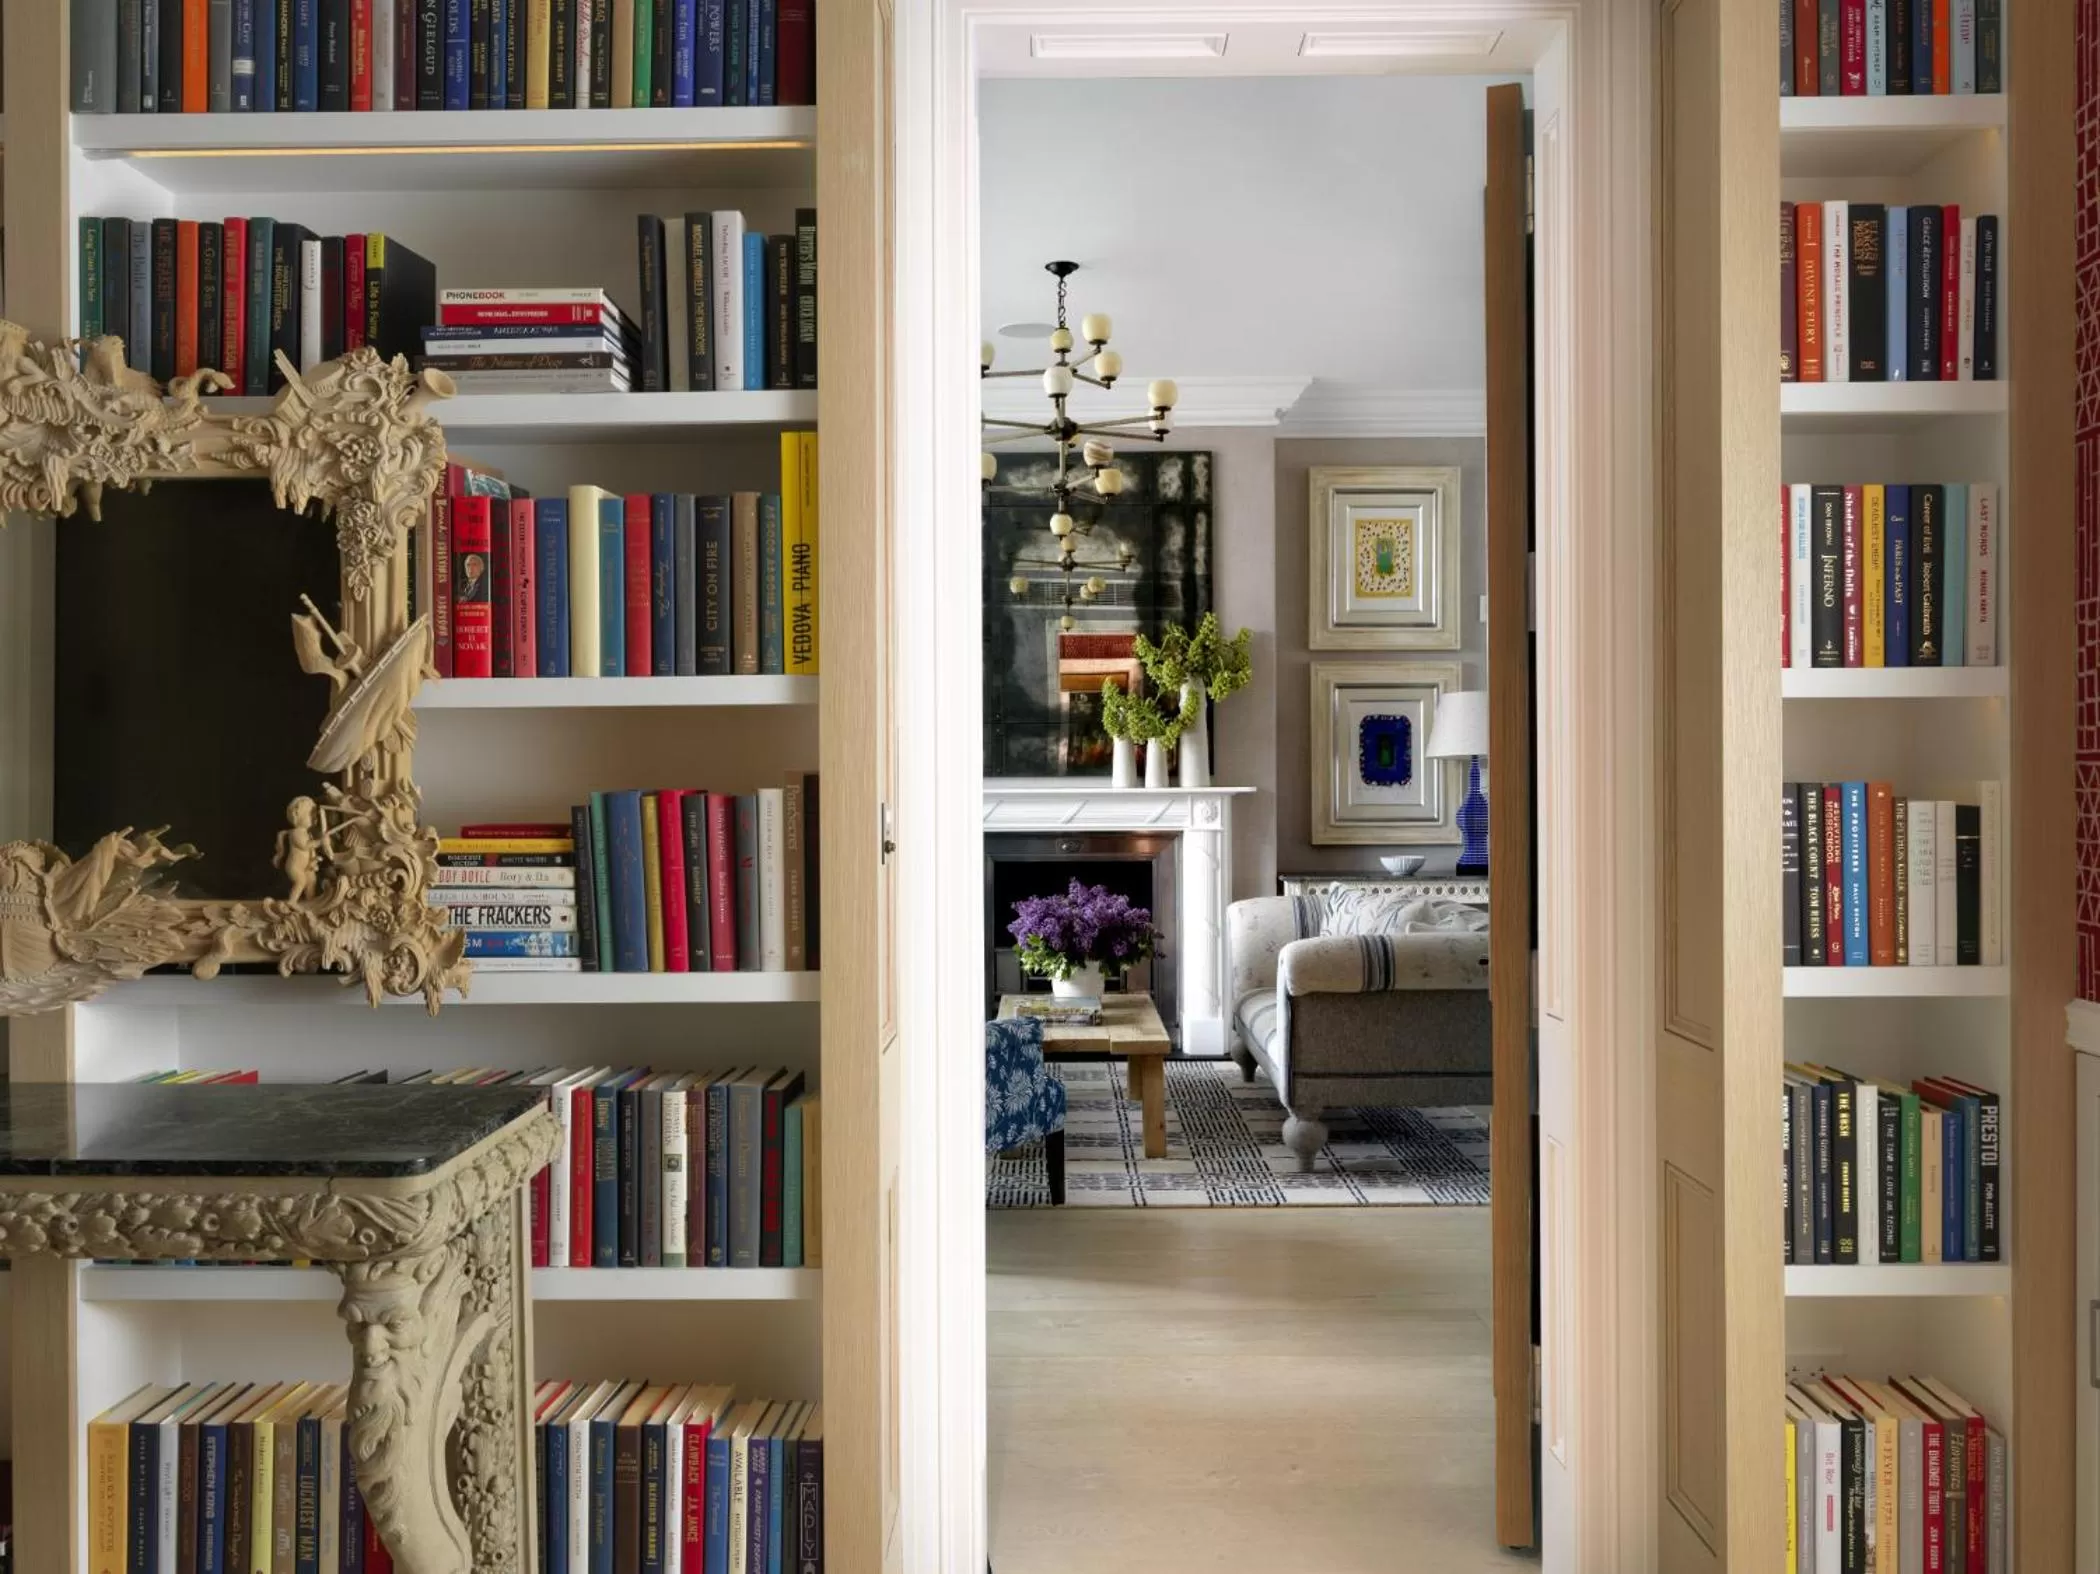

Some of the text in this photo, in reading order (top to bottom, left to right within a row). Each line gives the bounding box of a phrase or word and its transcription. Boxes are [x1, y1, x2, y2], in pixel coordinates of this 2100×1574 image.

[422, 12, 437, 75] GIELGUD
[708, 5, 721, 54] POWERS
[86, 228, 96, 250] Long
[275, 247, 284, 263] THE
[691, 224, 703, 257] MICHAEL
[87, 251, 95, 271] Time
[204, 248, 215, 281] Good
[692, 258, 704, 297] CONNELLY
[1833, 261, 1841, 292] MOSAIC
[1921, 246, 1932, 298] REVOLUTION
[274, 264, 285, 303] HAUNTED
[350, 285, 362, 310] Alley
[369, 281, 381, 299] Life
[446, 291, 505, 300] PHONEBOOK
[1804, 259, 1816, 343] DIVINE FURY
[1825, 503, 1833, 545] DAN BROWN
[1871, 497, 1880, 541] DEADLIEST
[1980, 498, 1988, 521] LAST
[1844, 492, 1855, 598] Shadow of the Dolls
[1871, 543, 1880, 571] ENEMY
[1979, 524, 1988, 557] WORDS
[1821, 555, 1838, 607] INFERNO
[1894, 539, 1903, 605] PARIS PAST
[1922, 493, 1933, 636] Career of Evil Robert Galbraith
[705, 541, 719, 631] CITY ON FIRE
[791, 541, 813, 663] VEDOVA PIANO
[1851, 789, 1859, 807] THE
[1851, 813, 1860, 873] PROFITEERS
[1807, 791, 1819, 939] THE BLACK COUNT TOM REISS
[1896, 863, 1905, 892] KILLER
[447, 904, 552, 925] THE FRACKERS
[1839, 1092, 1849, 1110] THE
[1839, 1112, 1850, 1136] RUSH
[1886, 1123, 1894, 1139] THE
[1980, 1105, 1998, 1167] PRESTO!
[1886, 1143, 1894, 1162] TSAR
[1886, 1176, 1894, 1197] LOVE
[1886, 1215, 1894, 1246] TECHNO
[1928, 1433, 1941, 1446] THE
[687, 1433, 700, 1484] CLAWBACK
[1950, 1432, 1965, 1490] Horowitz
[206, 1436, 217, 1520] STEPHEN KING
[732, 1452, 744, 1503] AVAILABLE
[299, 1475, 315, 1561] LUCKIEST MAN
[1928, 1490, 1941, 1516] TRUTH
[686, 1515, 699, 1543] JANCE
[802, 1487, 816, 1556] MADLY
